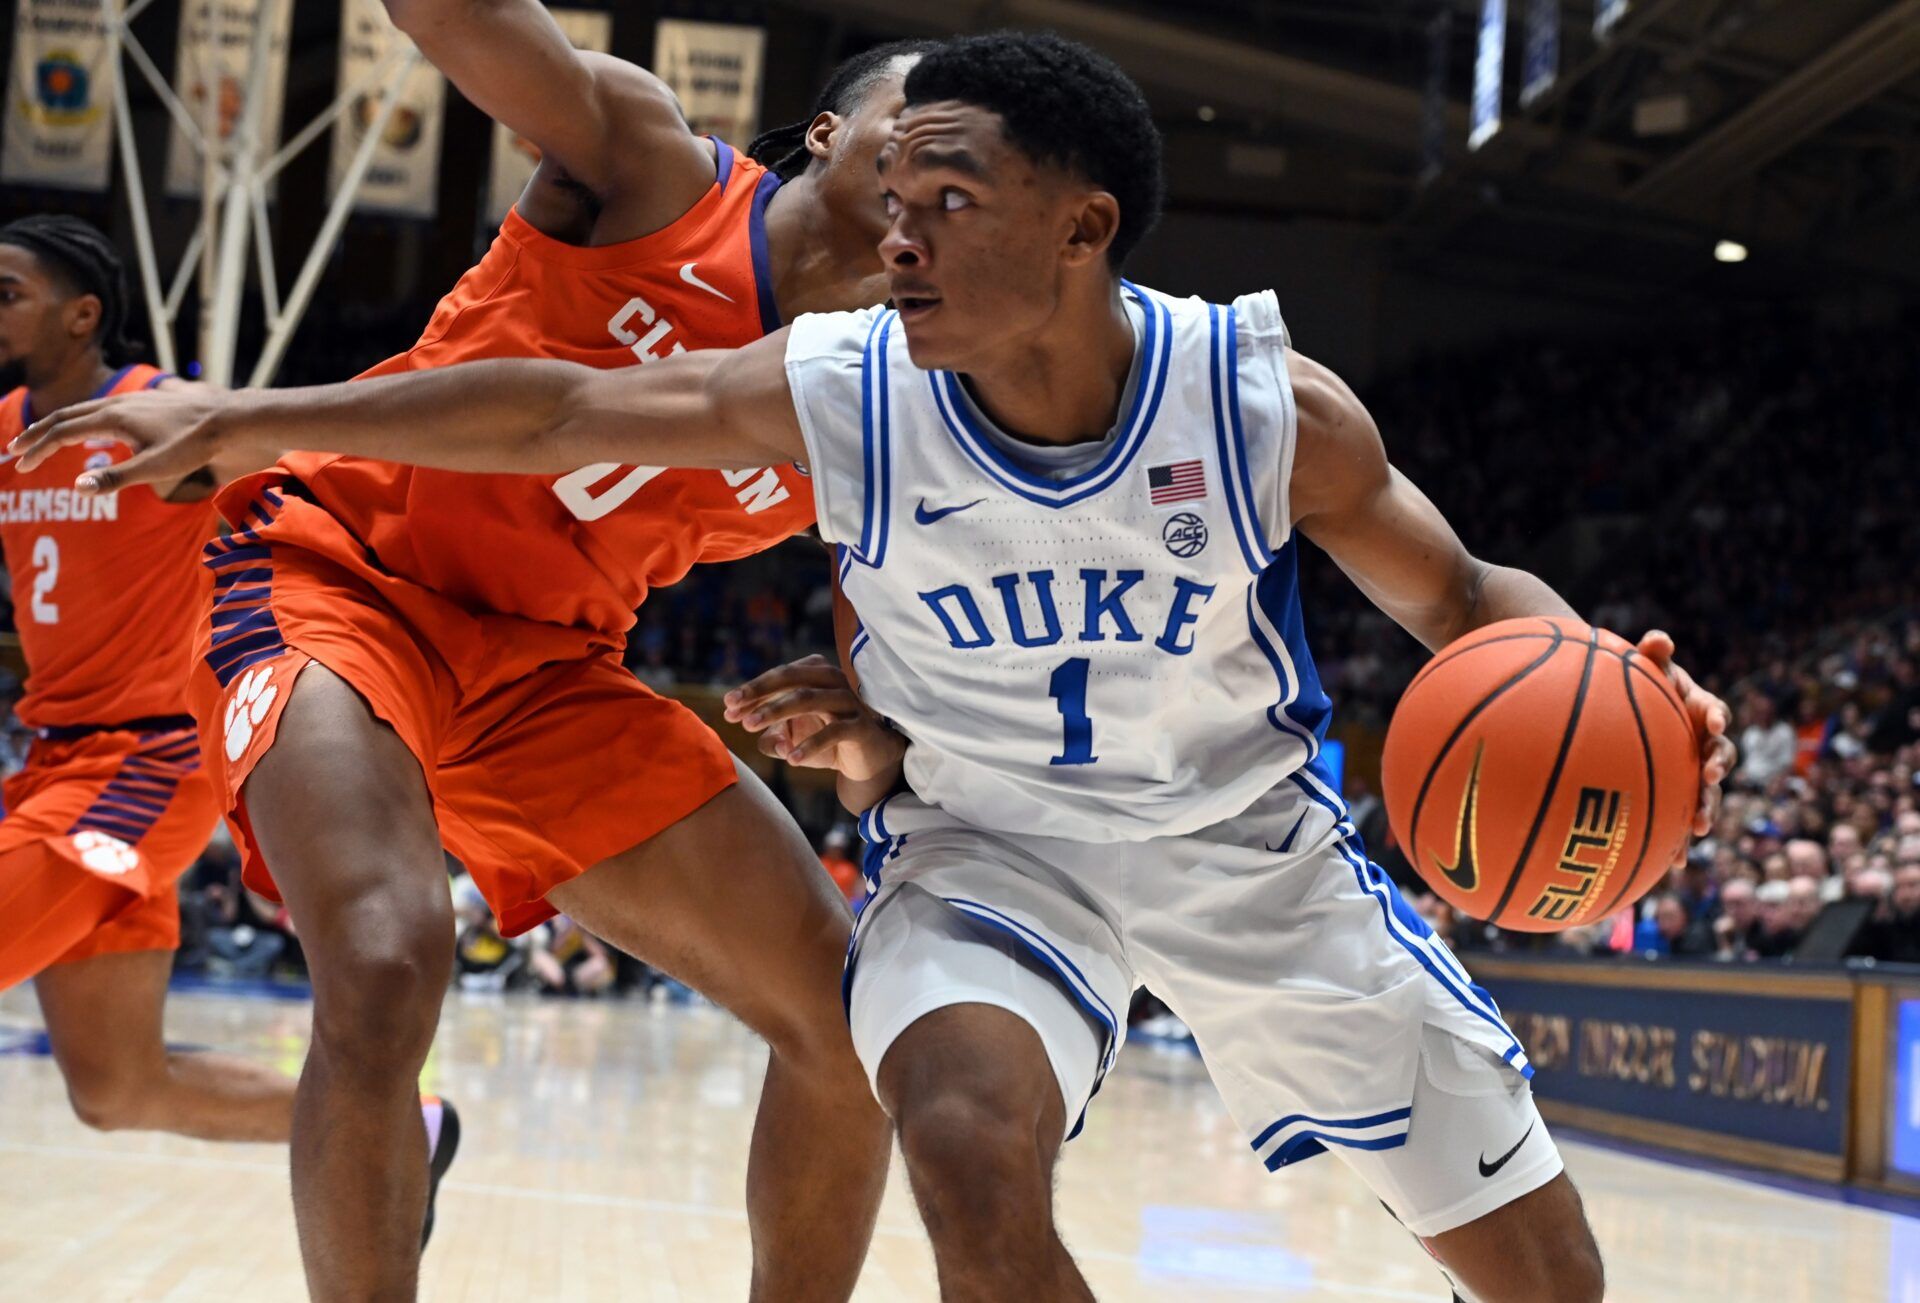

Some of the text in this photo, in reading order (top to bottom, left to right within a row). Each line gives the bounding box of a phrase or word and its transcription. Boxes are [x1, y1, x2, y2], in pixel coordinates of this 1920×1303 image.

[1167, 525, 1205, 541] ACC
[32, 535, 59, 624] 2
[917, 568, 1217, 656] DUKE
[1048, 657, 1099, 766] 1
[1527, 786, 1621, 921] ELITE
